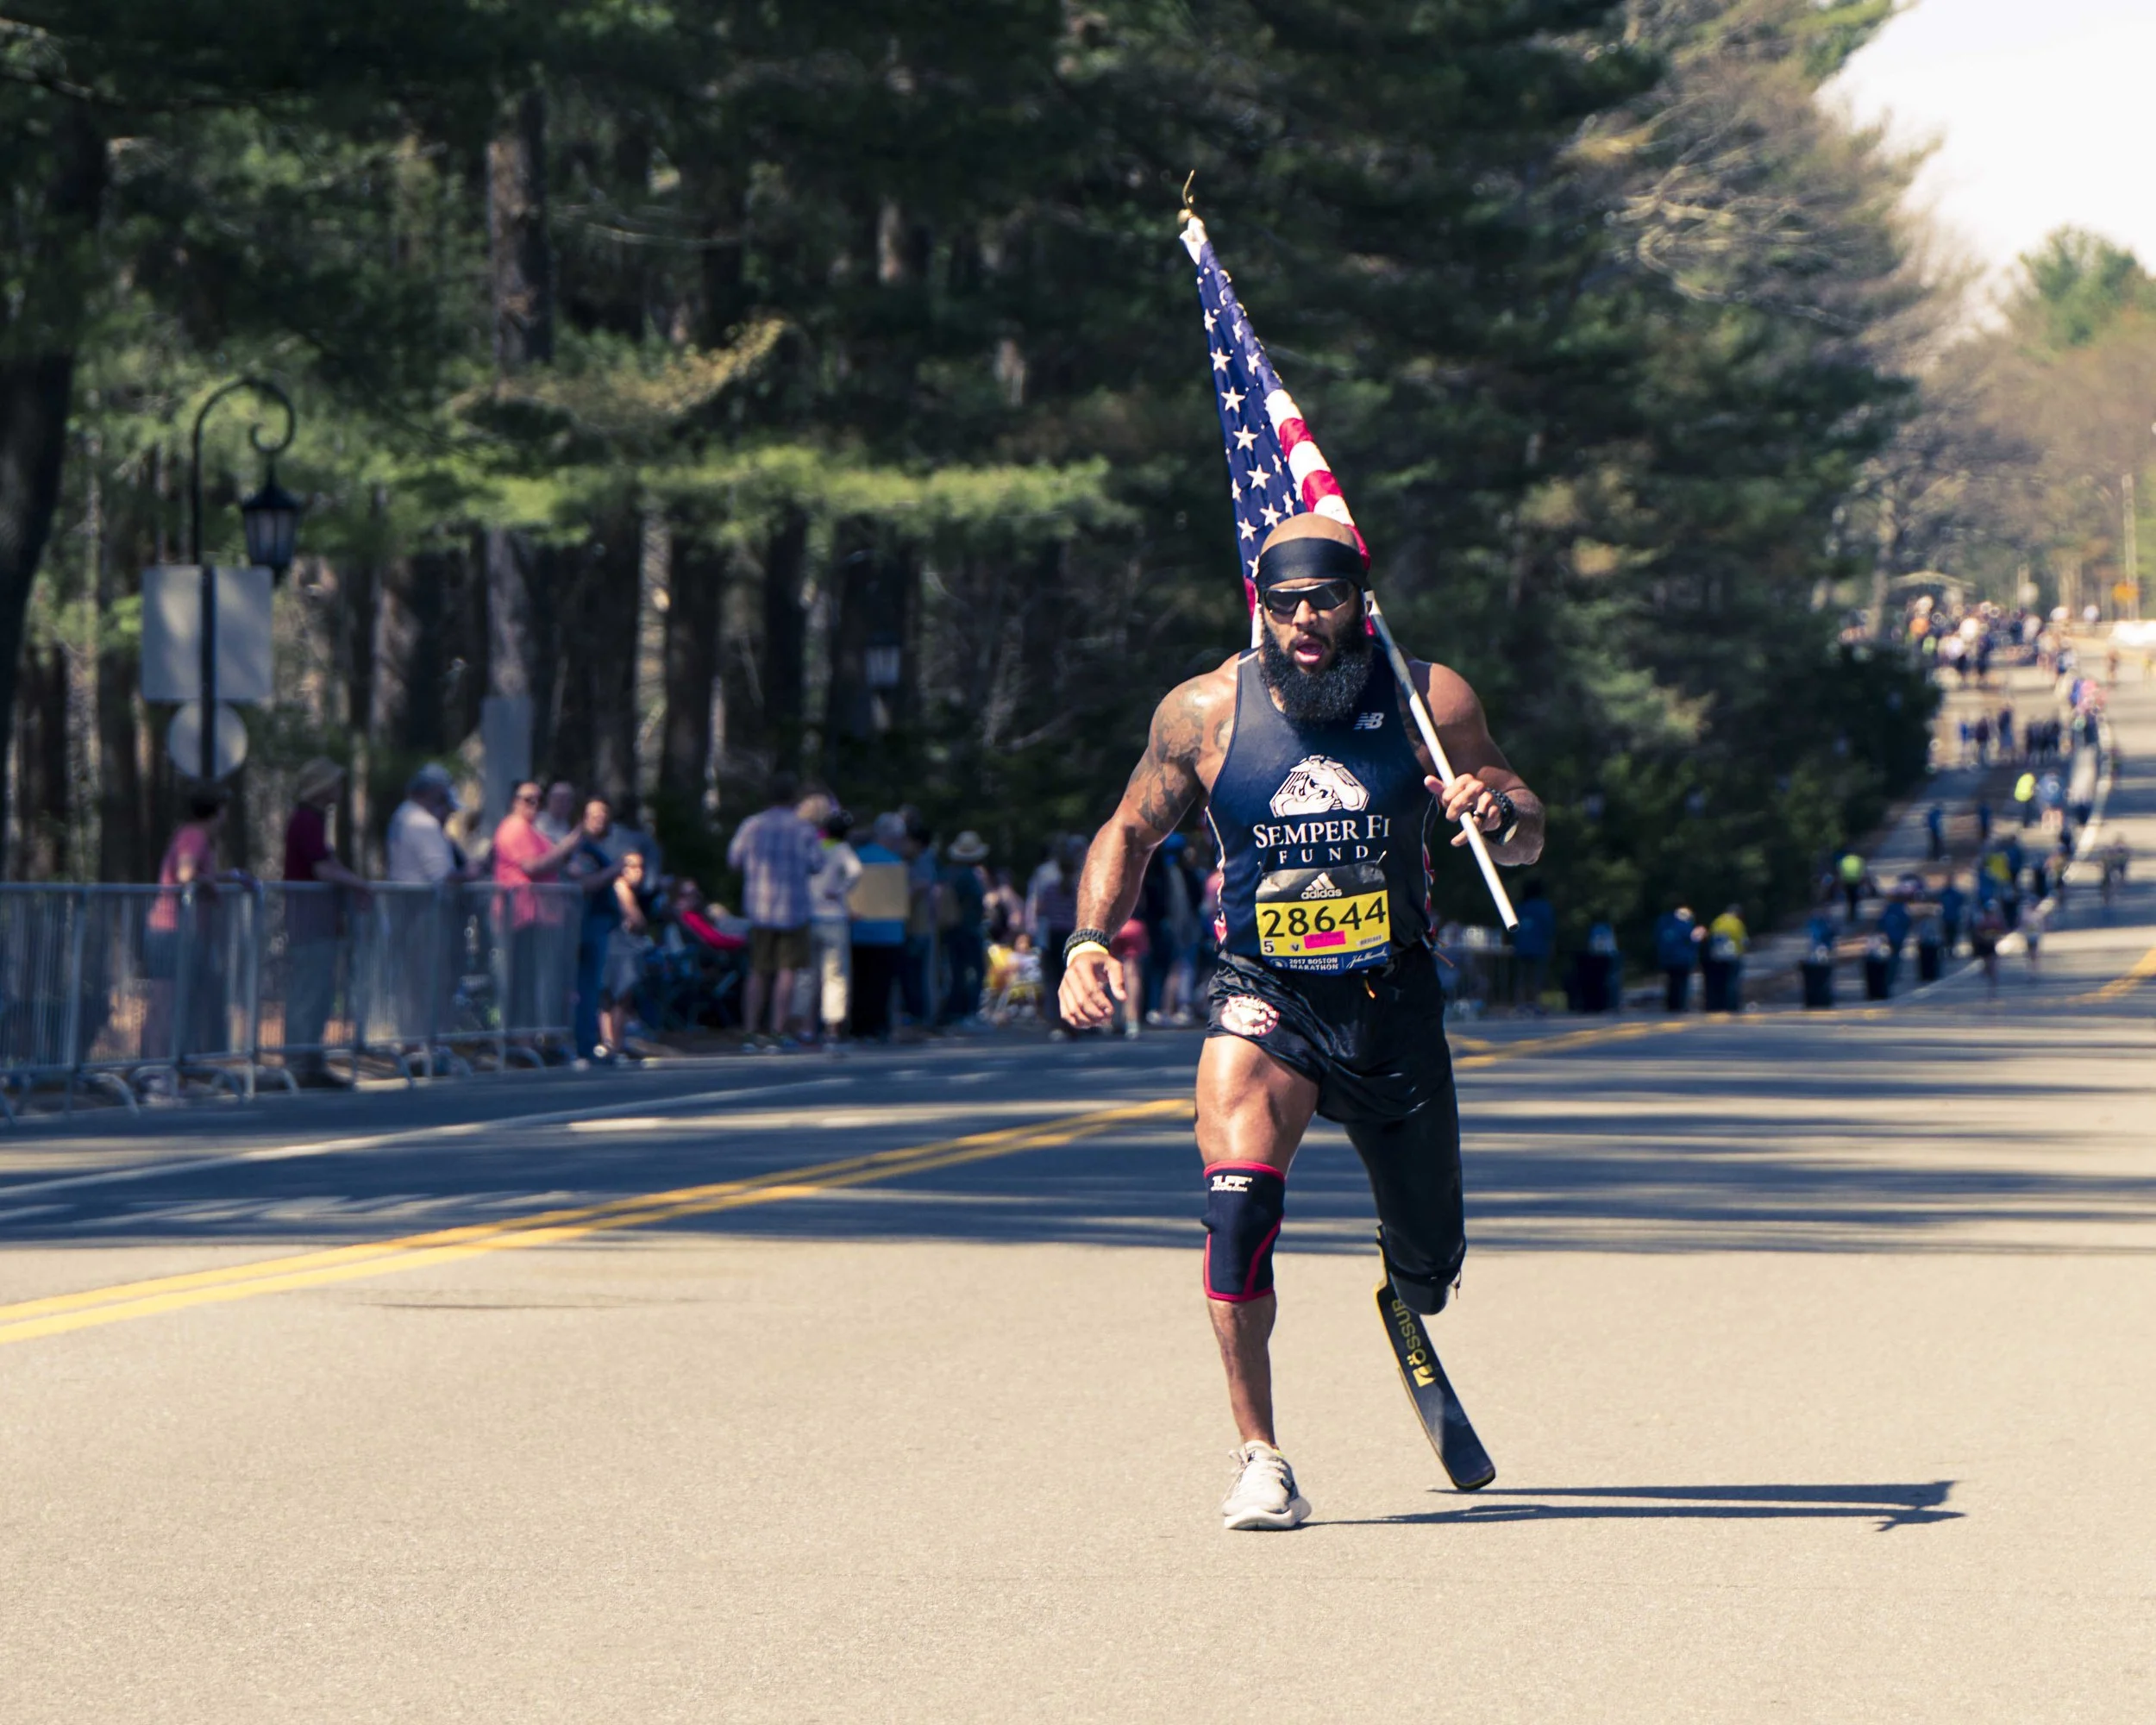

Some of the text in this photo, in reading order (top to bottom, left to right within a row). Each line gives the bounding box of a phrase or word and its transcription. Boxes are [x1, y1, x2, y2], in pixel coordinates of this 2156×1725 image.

[1253, 814, 1391, 849] SEMPER FI
[1279, 845, 1369, 864] FUND
[1300, 888, 1343, 900] adidas
[1262, 896, 1387, 938] 28644
[1263, 940, 1275, 953] 5
